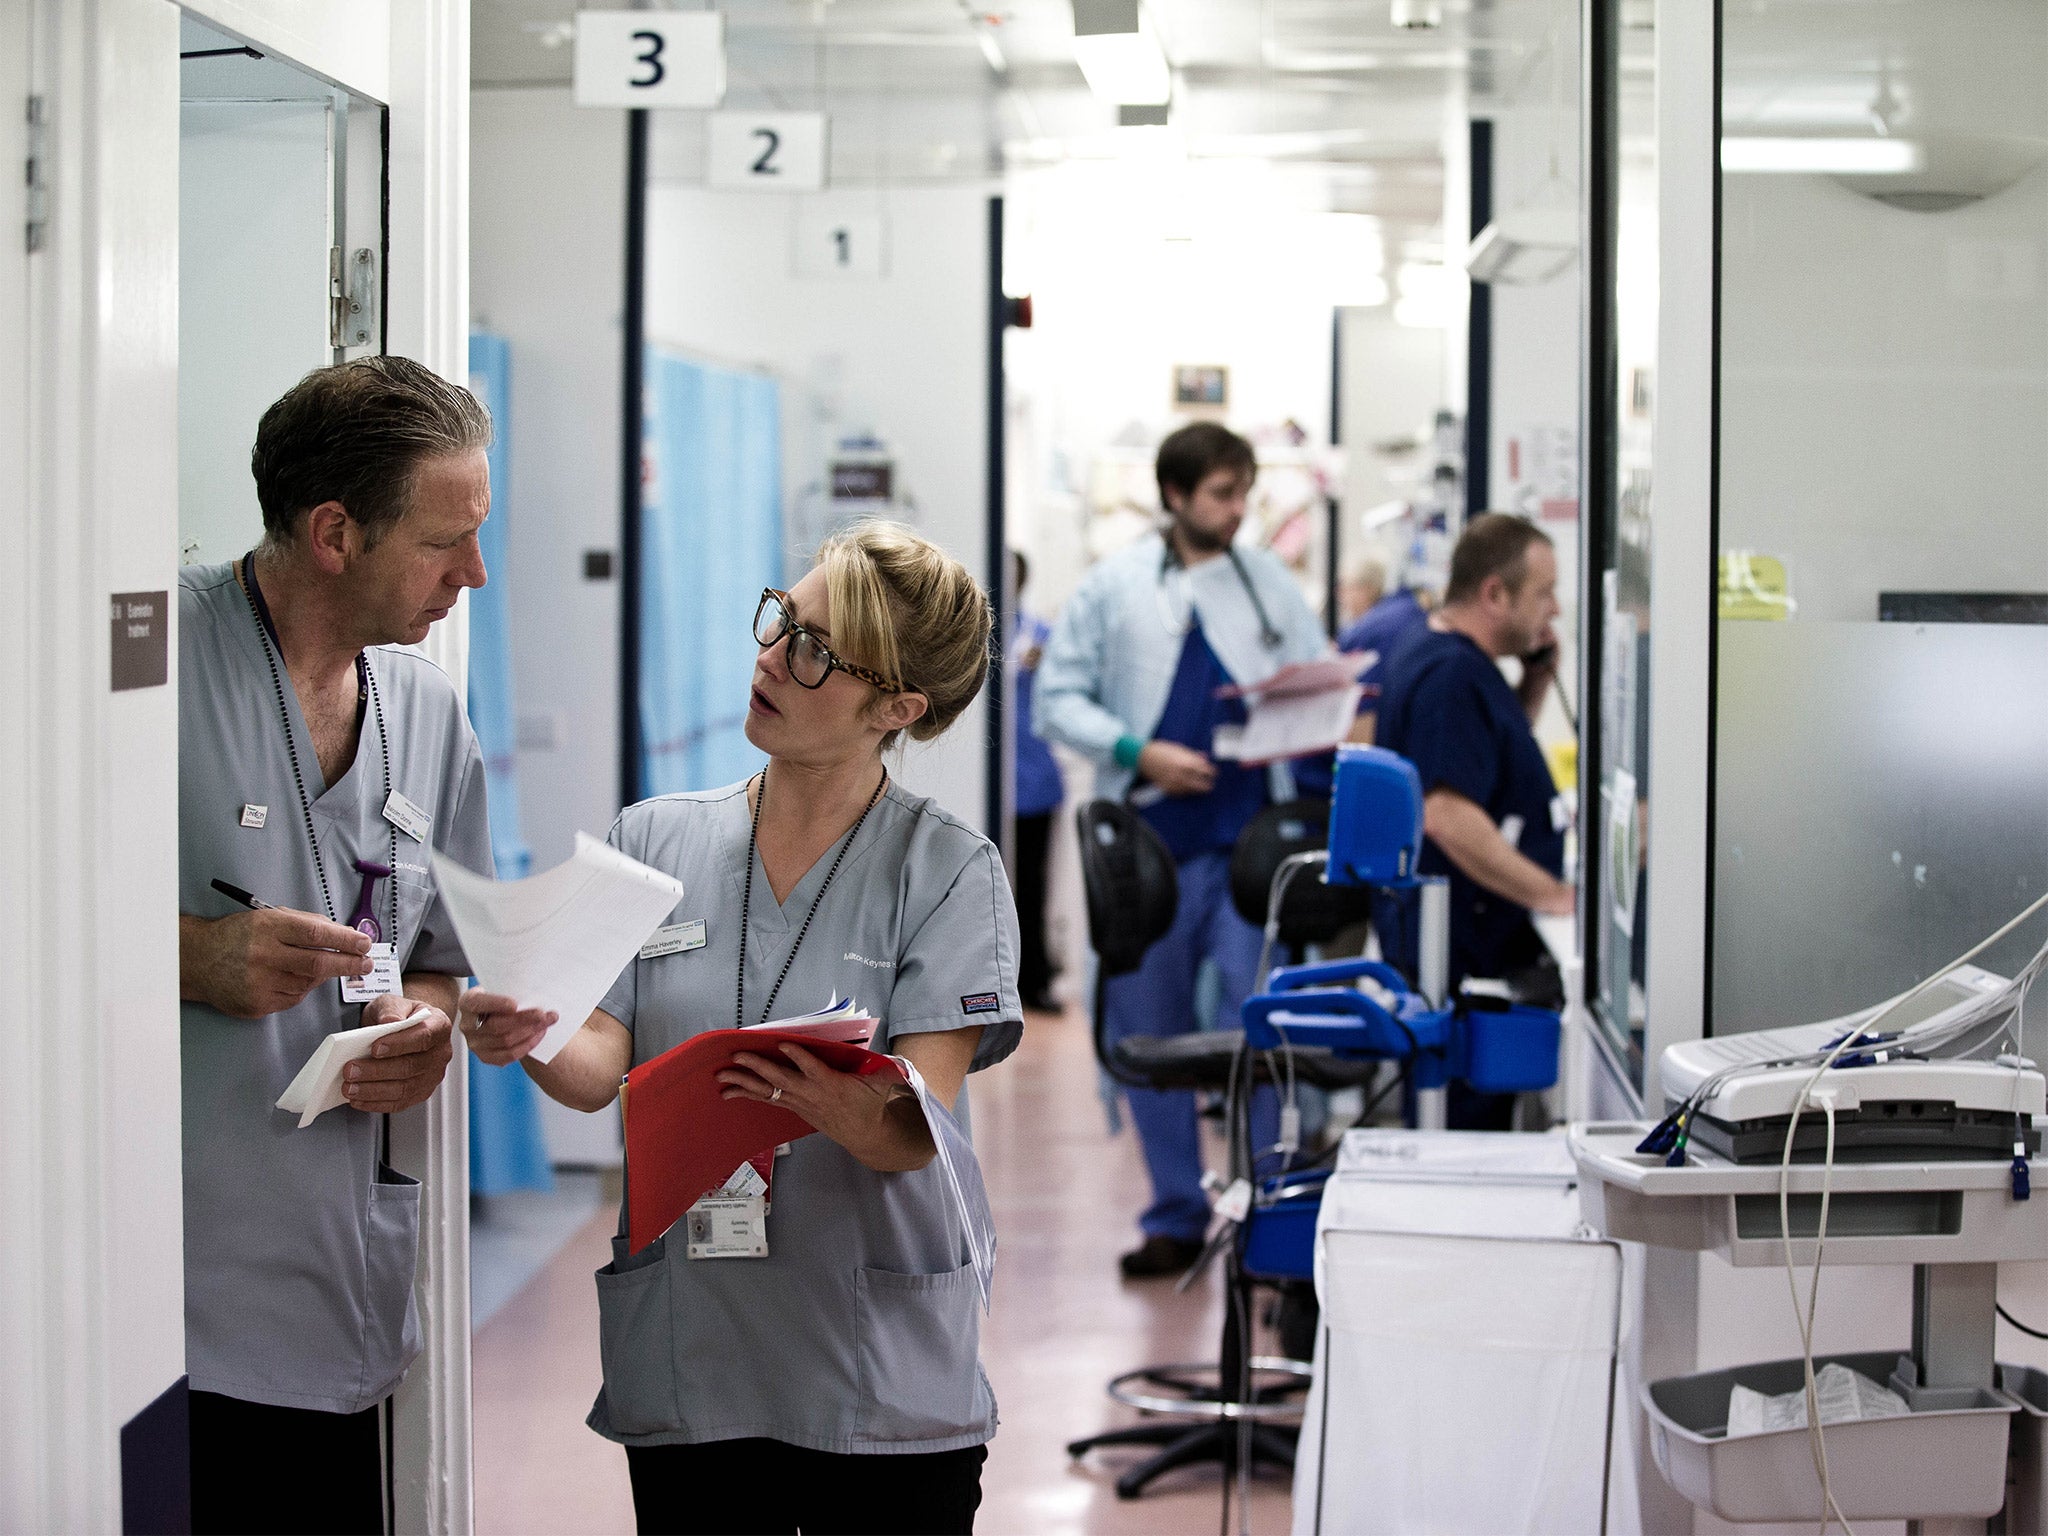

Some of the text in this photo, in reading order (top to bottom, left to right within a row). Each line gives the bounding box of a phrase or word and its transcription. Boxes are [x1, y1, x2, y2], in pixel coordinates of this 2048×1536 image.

[630, 30, 664, 87] 3
[751, 128, 780, 175] 2
[833, 230, 850, 265] 1
[641, 944, 659, 952] Emma
[843, 952, 863, 962] Milton
[863, 958, 891, 969] Keynes
